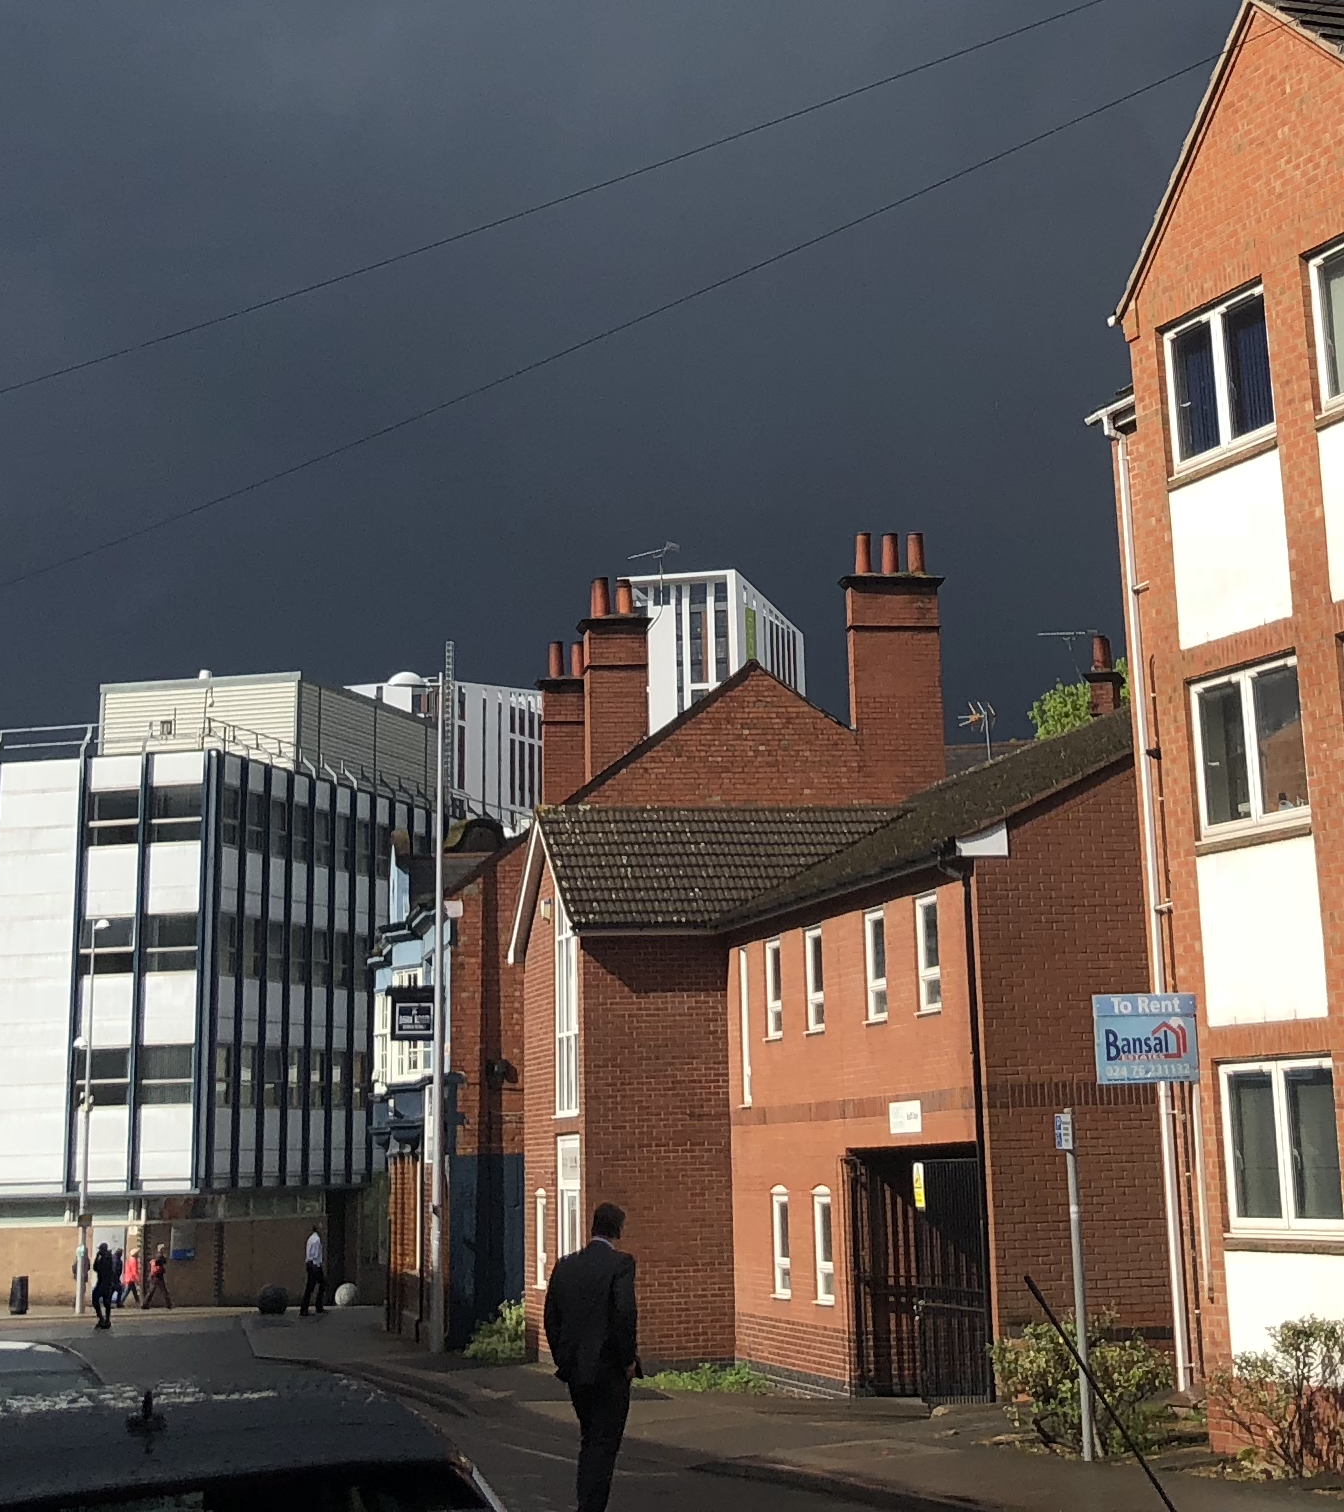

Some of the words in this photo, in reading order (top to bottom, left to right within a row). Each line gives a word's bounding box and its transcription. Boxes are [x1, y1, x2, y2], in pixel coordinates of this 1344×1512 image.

[1110, 996, 1132, 1014] To
[1137, 996, 1181, 1014] Rent
[1105, 1029, 1170, 1061] Bansal
